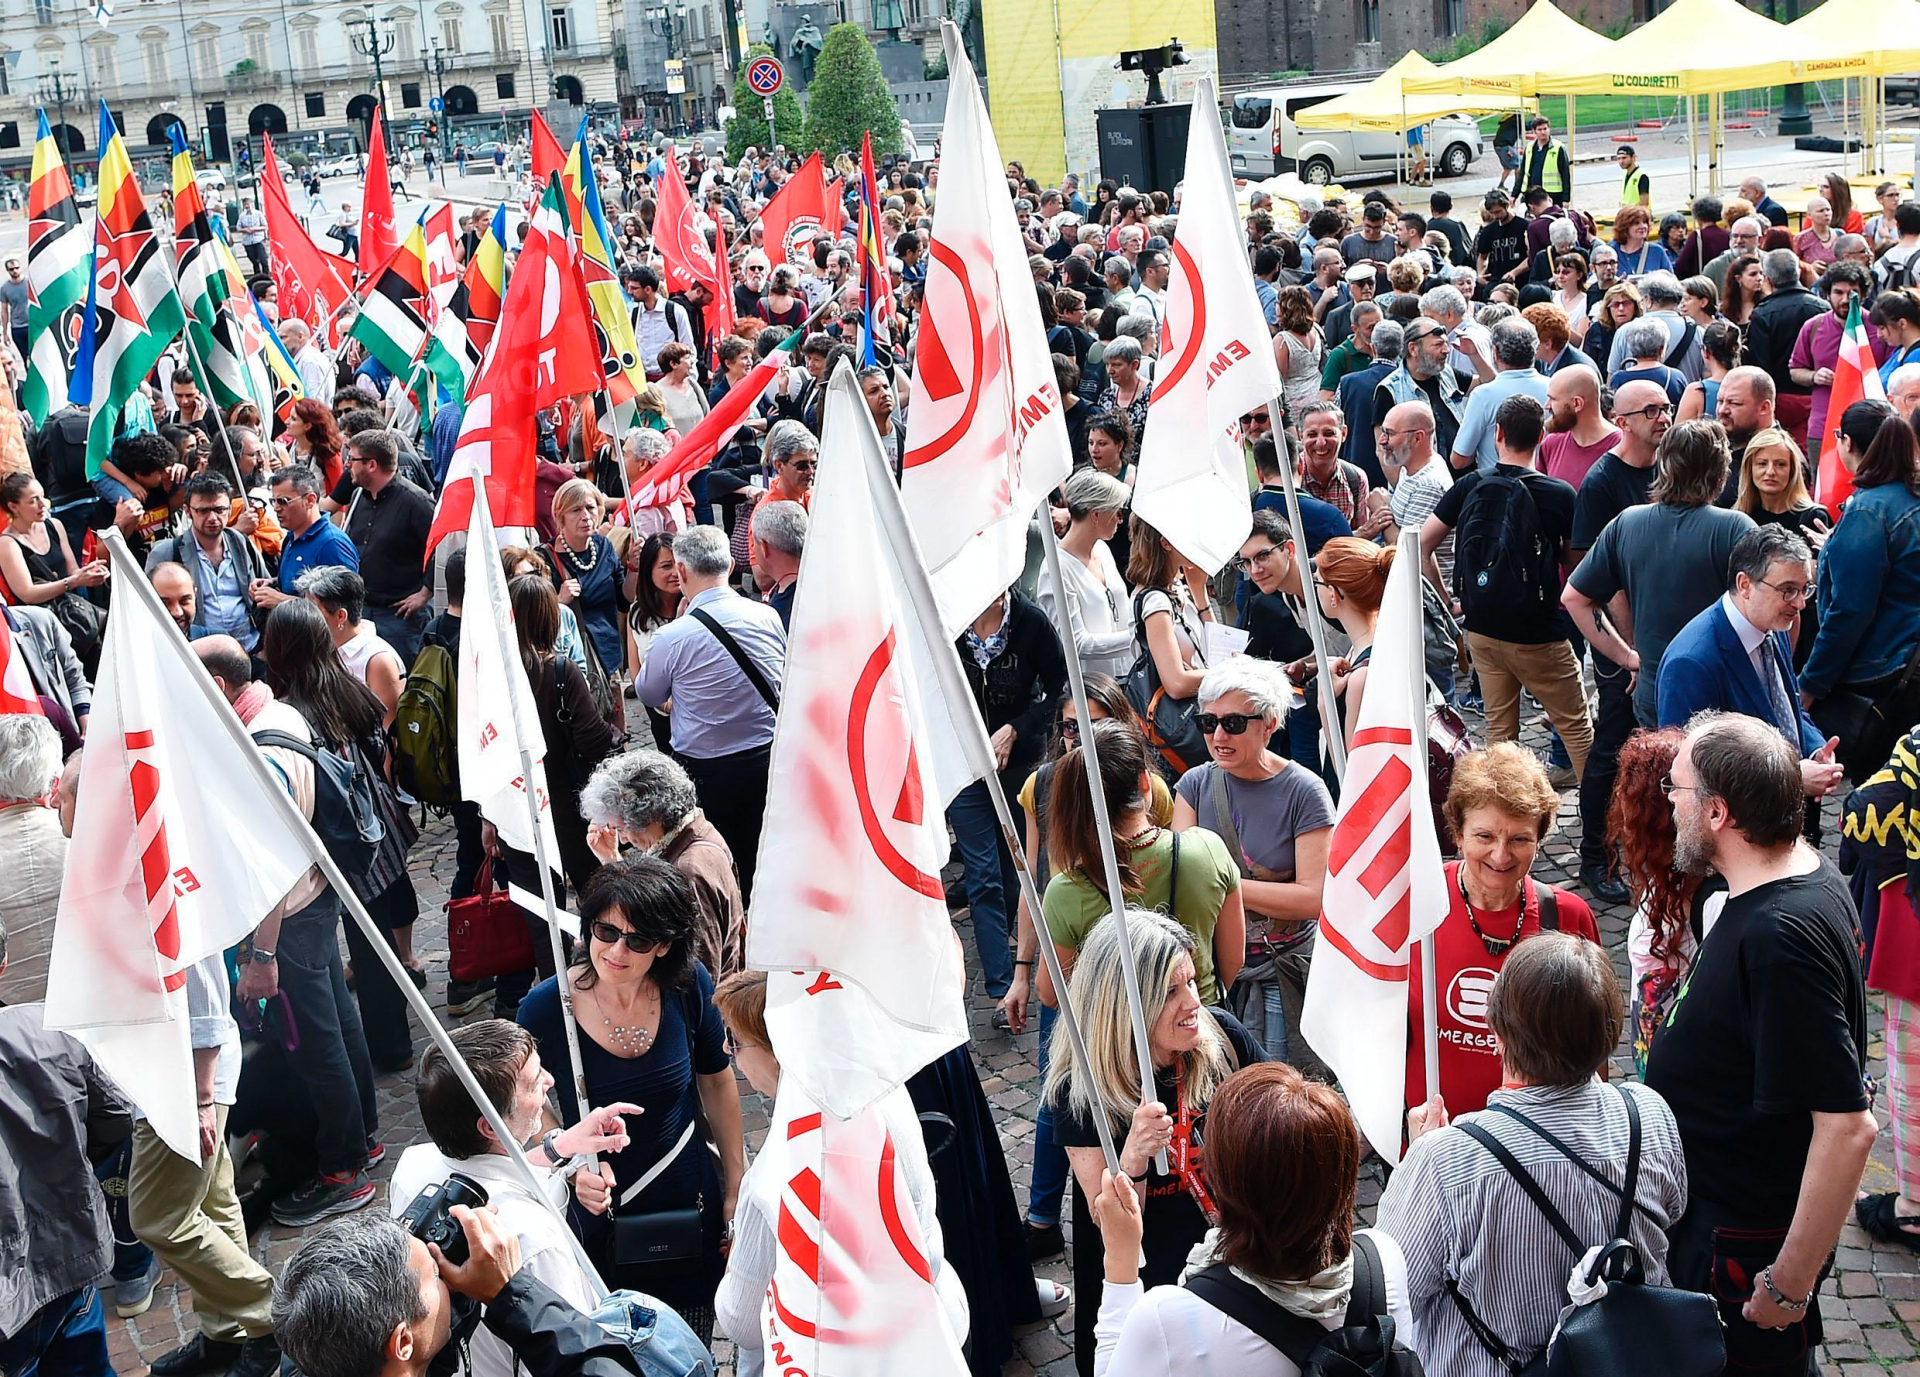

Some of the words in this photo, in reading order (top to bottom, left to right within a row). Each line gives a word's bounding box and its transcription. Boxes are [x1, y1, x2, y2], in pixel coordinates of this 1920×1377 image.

[1806, 61, 1842, 72] CAMPAGNA
[1844, 58, 1867, 67] AMICA
[1625, 75, 1680, 88] COLDIRETTI
[1436, 1026, 1499, 1048] MERGE
